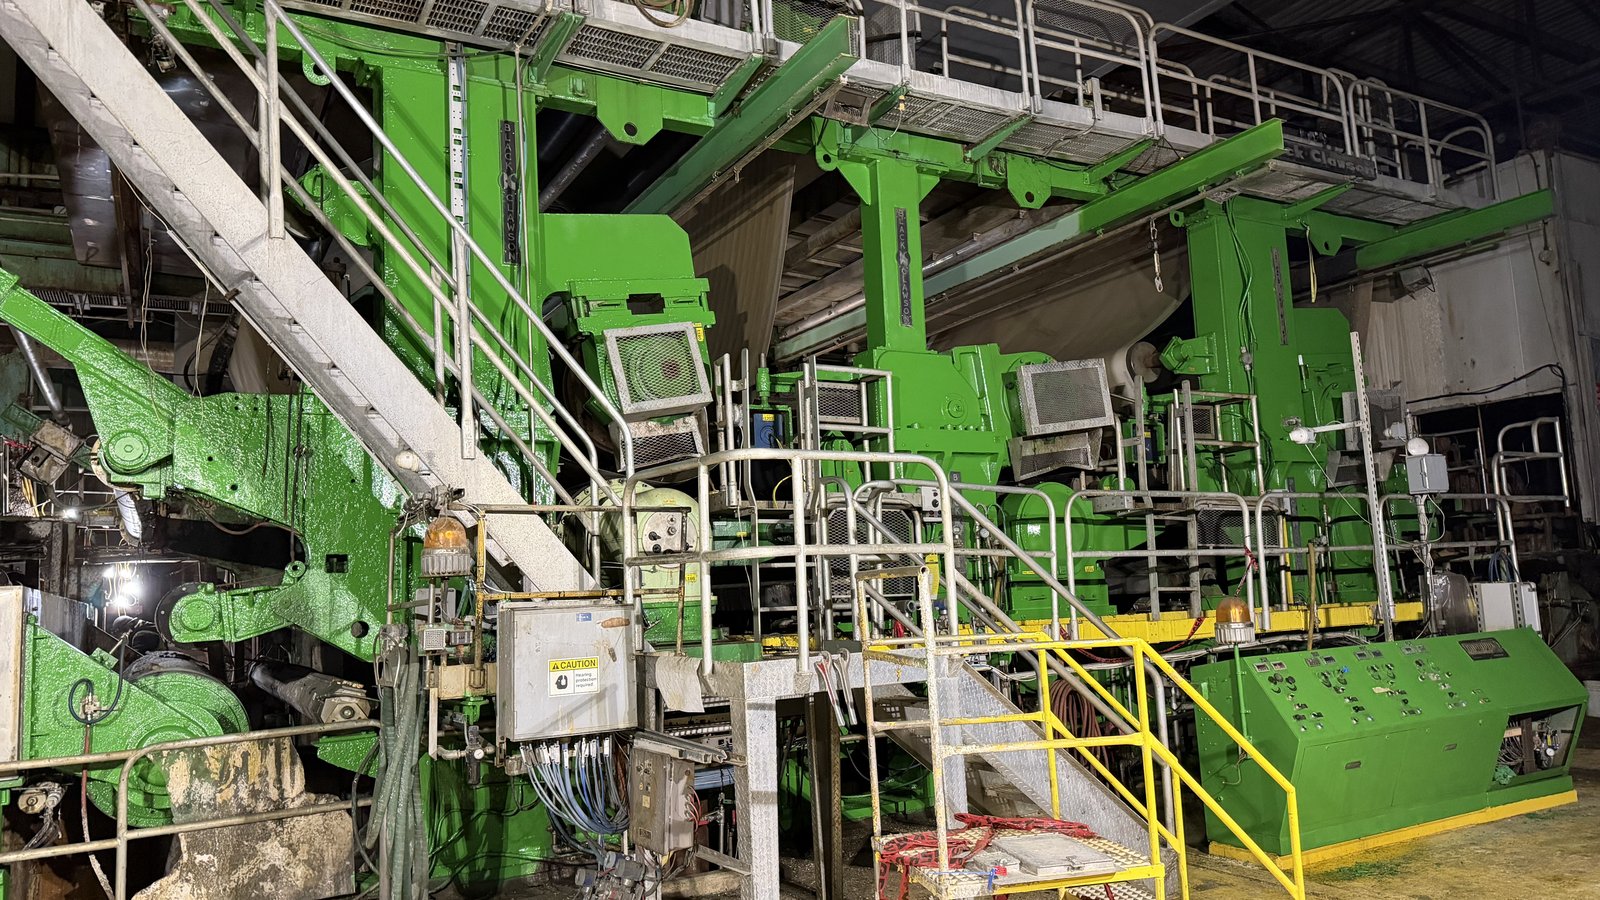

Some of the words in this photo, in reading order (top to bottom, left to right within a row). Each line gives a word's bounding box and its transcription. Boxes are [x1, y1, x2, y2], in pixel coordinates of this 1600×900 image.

[504, 123, 513, 170] BLACK
[506, 194, 515, 260] CLAWSON
[898, 208, 906, 250] BLACK
[901, 267, 910, 324] CLAWSON
[560, 659, 596, 669] CAUTION
